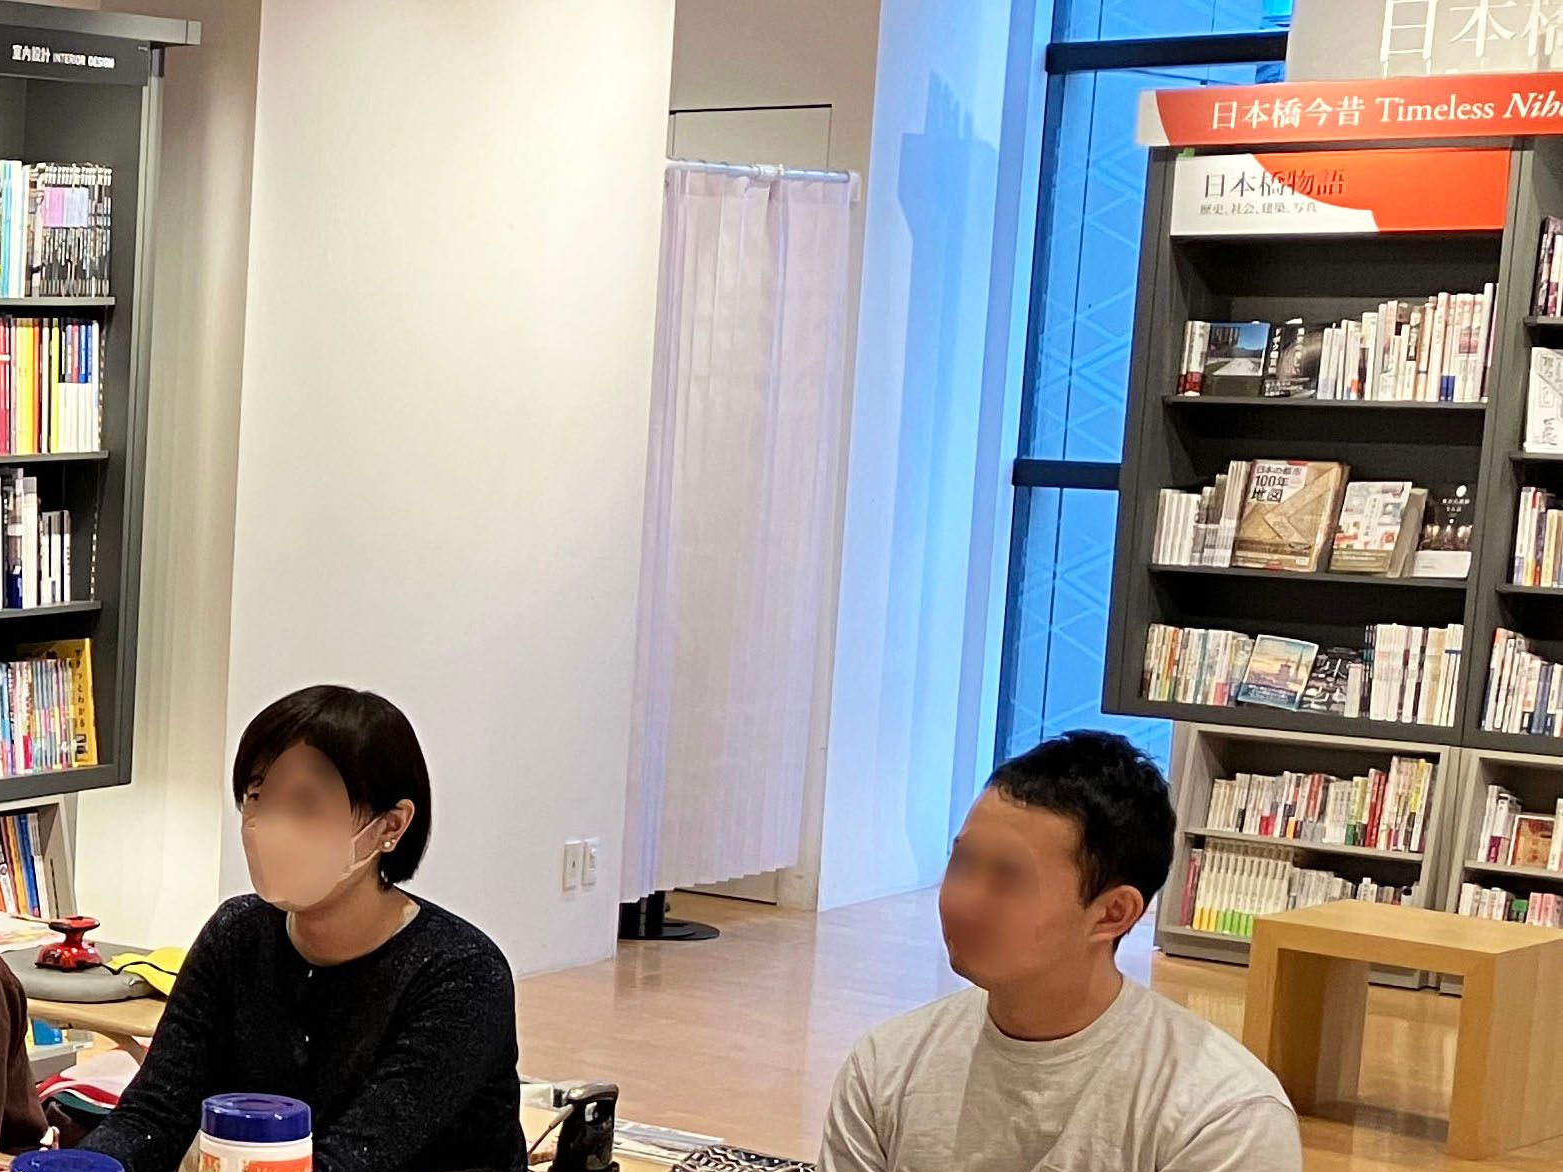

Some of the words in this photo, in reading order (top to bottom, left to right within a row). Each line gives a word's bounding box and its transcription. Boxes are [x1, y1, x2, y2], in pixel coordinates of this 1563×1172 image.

[53, 52, 86, 66] INTERIOR
[88, 55, 115, 69] DESIGN
[1212, 95, 1365, 130] 日本橋今昔
[1375, 94, 1495, 123] Timeless
[1204, 169, 1346, 198] 日本橋物語
[1256, 475, 1289, 487] 100年
[1250, 487, 1284, 503] 地図
